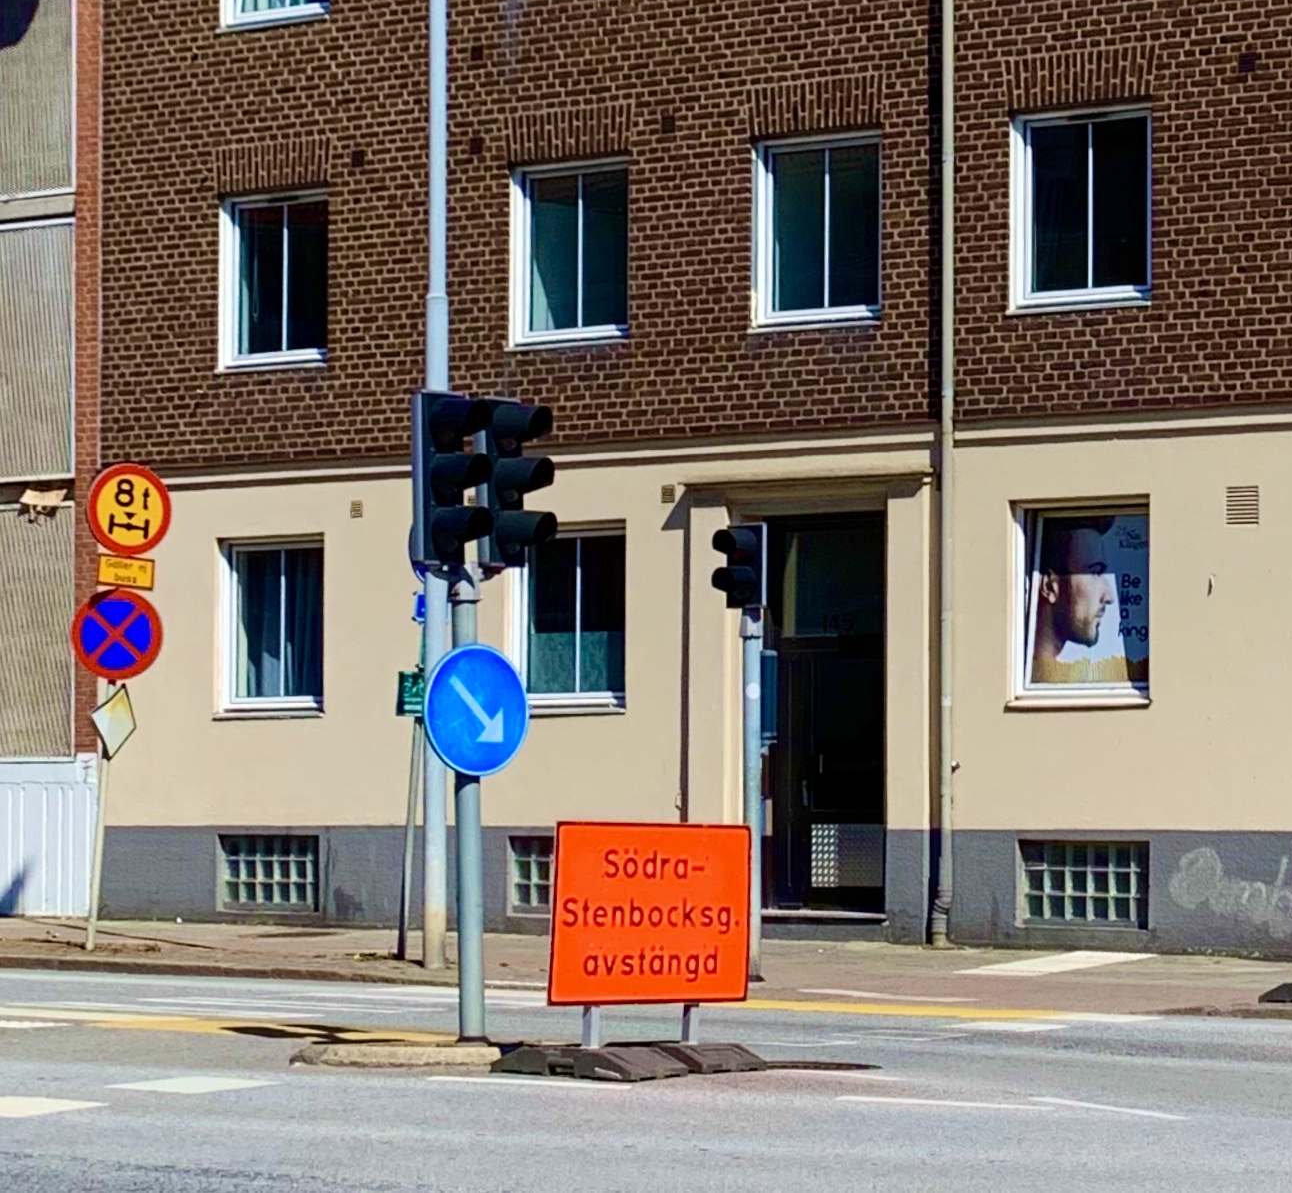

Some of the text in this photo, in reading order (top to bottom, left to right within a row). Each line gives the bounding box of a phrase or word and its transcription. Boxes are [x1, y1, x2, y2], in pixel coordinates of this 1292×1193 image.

[114, 478, 149, 510] 8 t
[113, 573, 137, 584] buss
[1121, 574, 1142, 589] Be
[1120, 591, 1143, 606] like
[822, 612, 855, 632] 145
[1120, 608, 1130, 619] a
[1118, 621, 1148, 642] king
[603, 847, 706, 880] Södra-
[562, 897, 740, 934] Stenbocksg.
[583, 944, 719, 983] avstängd
